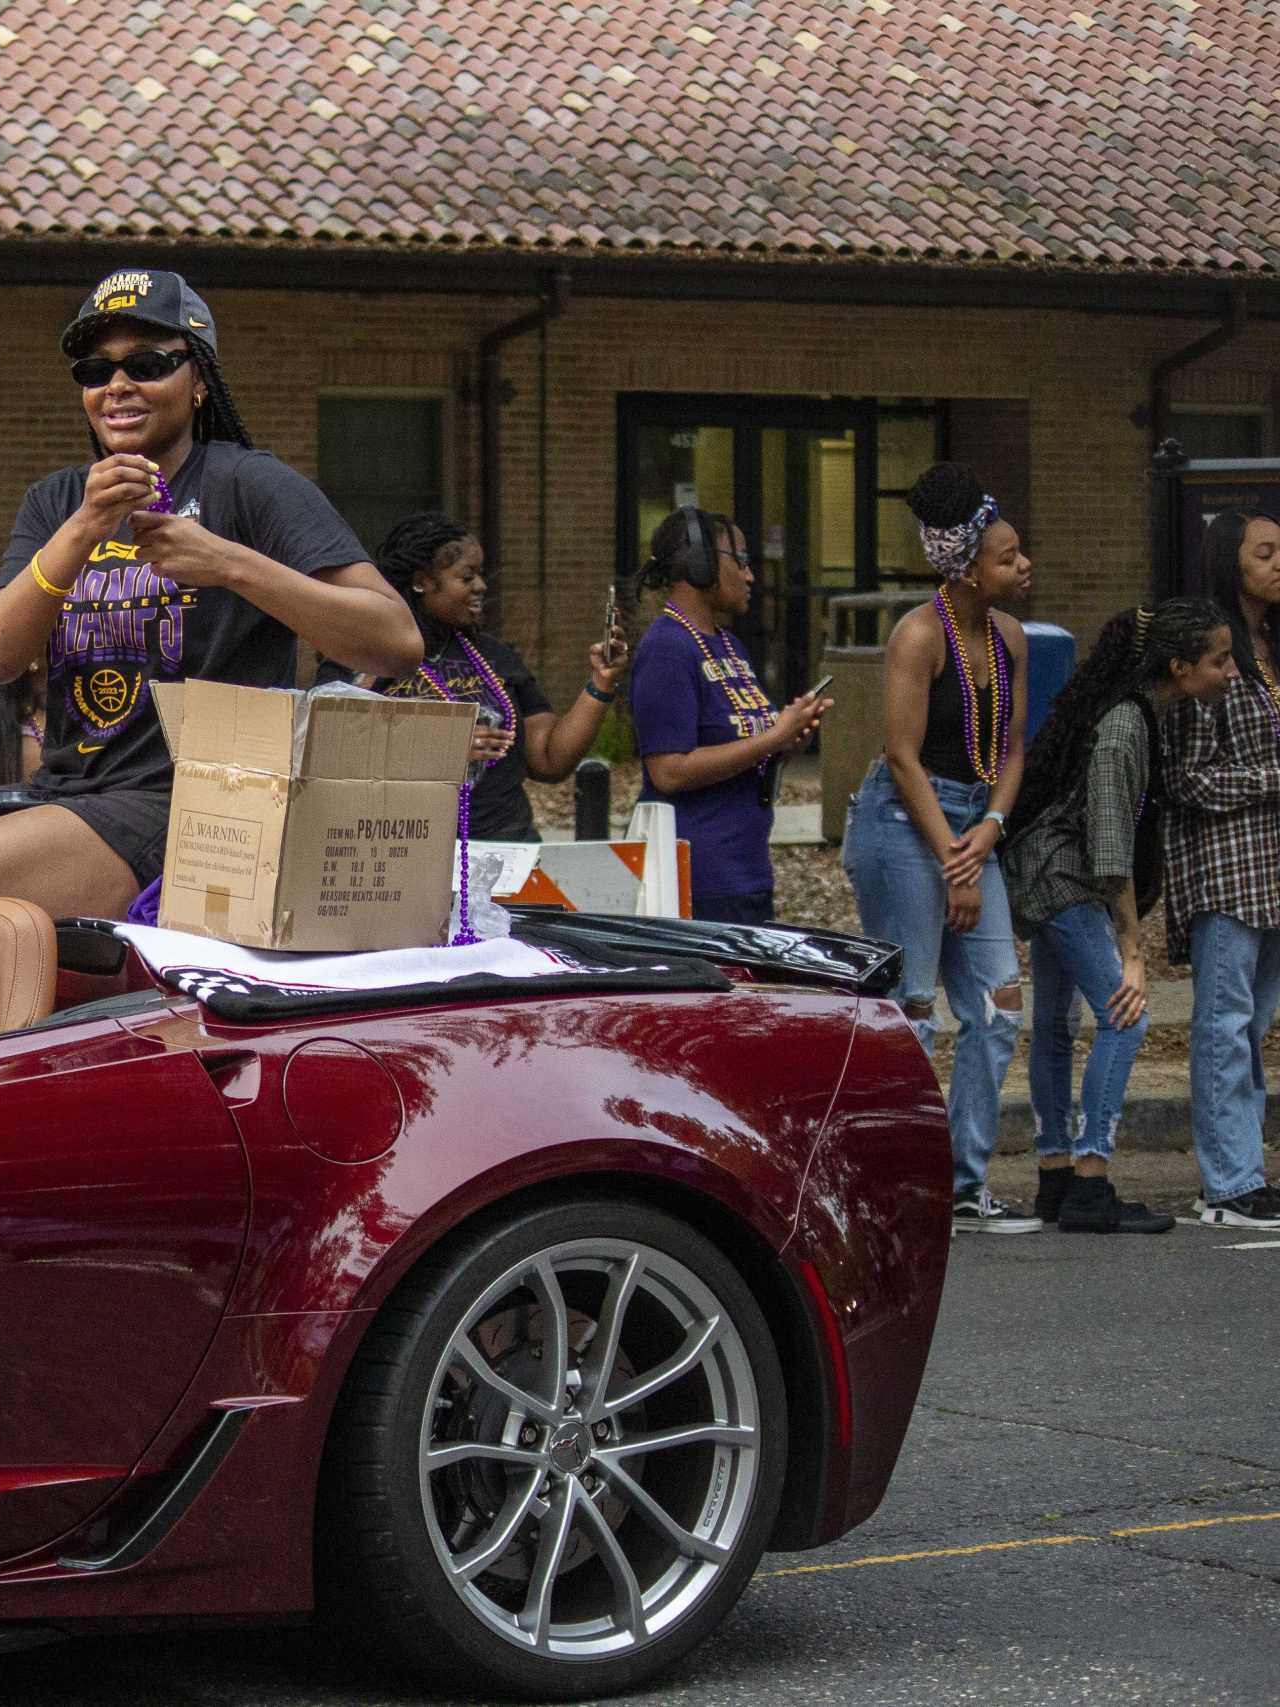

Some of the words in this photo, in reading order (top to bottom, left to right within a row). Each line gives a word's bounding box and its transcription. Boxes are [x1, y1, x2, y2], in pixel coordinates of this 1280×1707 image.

[197, 822, 251, 845] WARNING:
[357, 818, 429, 842] PB/1042M05
[374, 862, 386, 873] LBS
[373, 876, 385, 887] LBS
